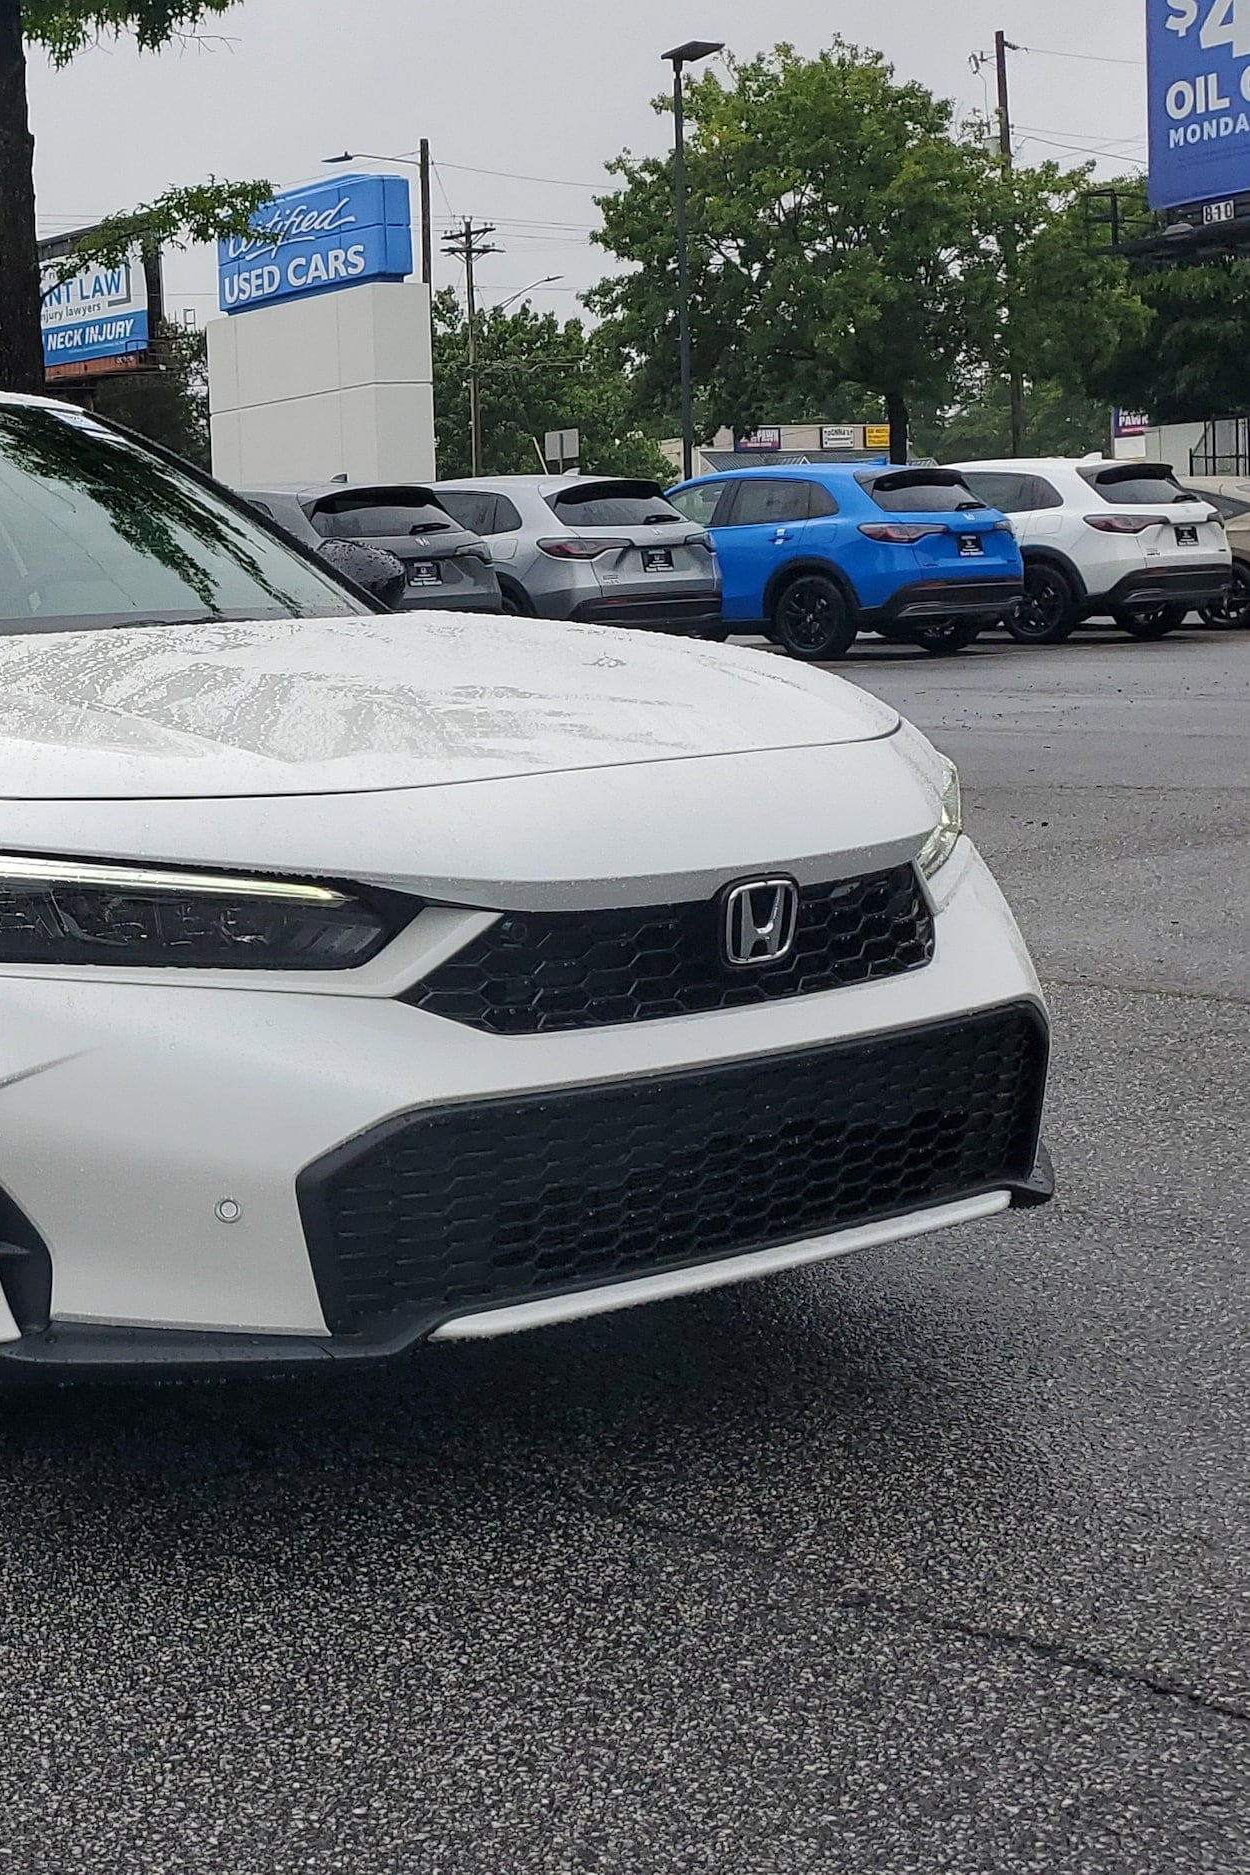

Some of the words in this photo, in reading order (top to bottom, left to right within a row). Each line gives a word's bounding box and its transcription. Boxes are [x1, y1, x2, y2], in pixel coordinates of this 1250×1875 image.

[1165, 73, 1230, 120] OIL
[1169, 113, 1250, 149] MONDA
[79, 271, 121, 301] LAW
[224, 265, 281, 304] USED
[287, 244, 366, 287] CARS
[40, 310, 64, 323] njury
[65, 302, 101, 317] lawyers
[47, 328, 84, 351] NECK
[84, 319, 135, 345] INJURY
